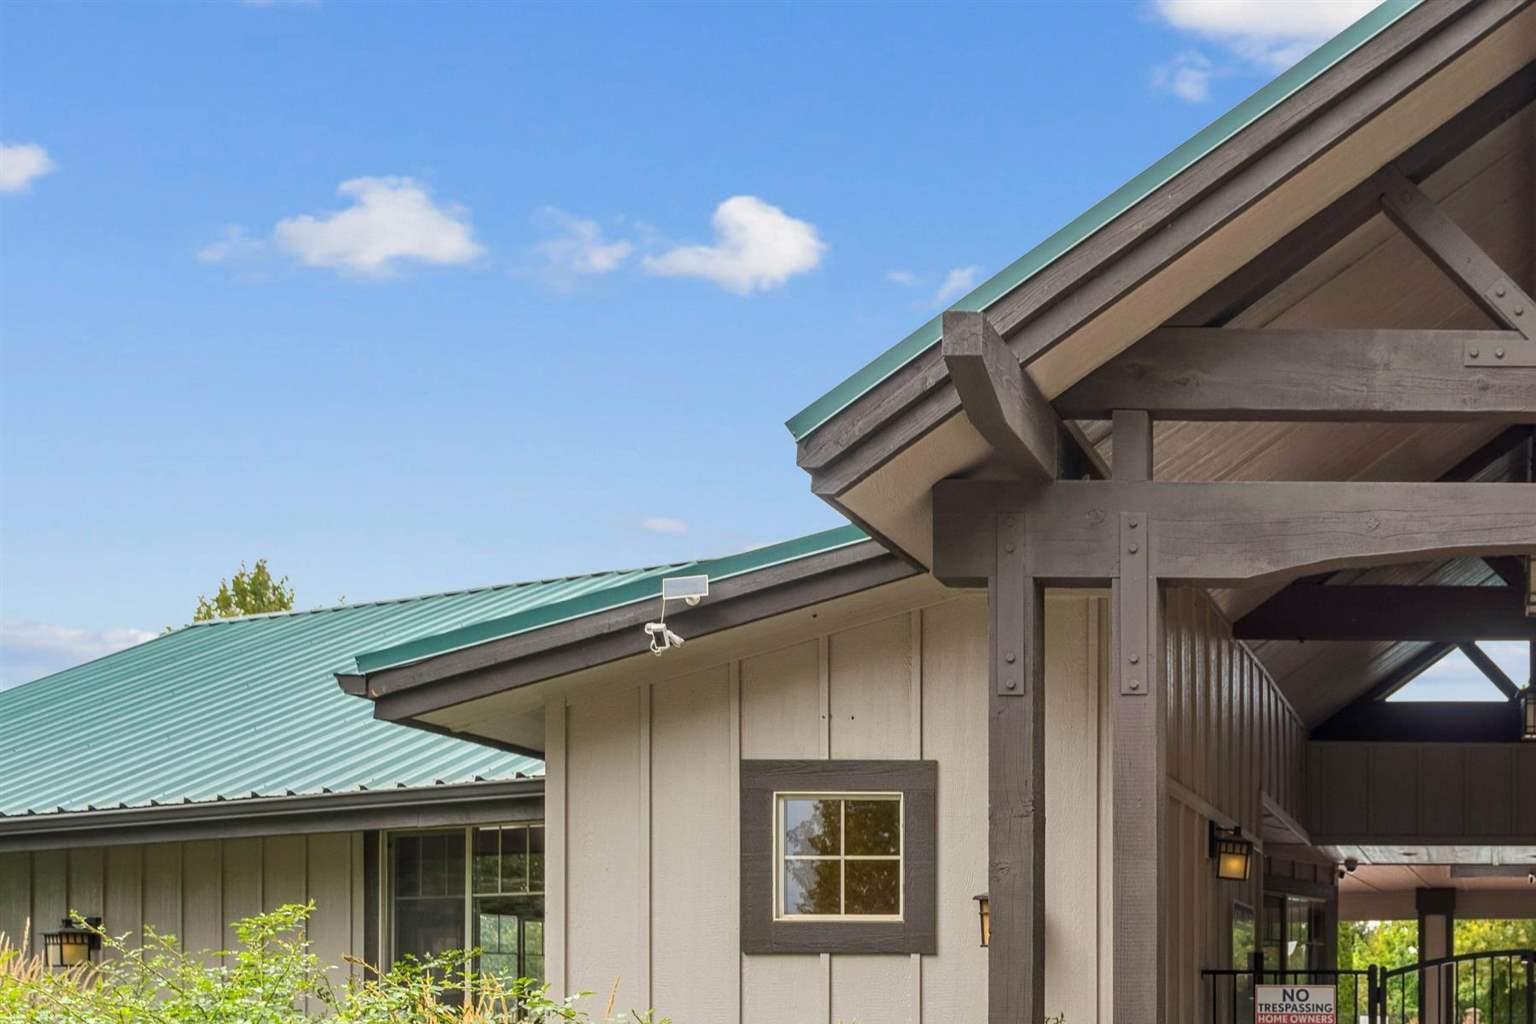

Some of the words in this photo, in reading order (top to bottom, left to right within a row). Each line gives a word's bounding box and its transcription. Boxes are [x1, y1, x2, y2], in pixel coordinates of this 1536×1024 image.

[1282, 989, 1309, 1002] NO
[1258, 1003, 1333, 1013] TRESPASSING
[1258, 1015, 1288, 1023] HOME
[1290, 1015, 1333, 1024] OWNERS
